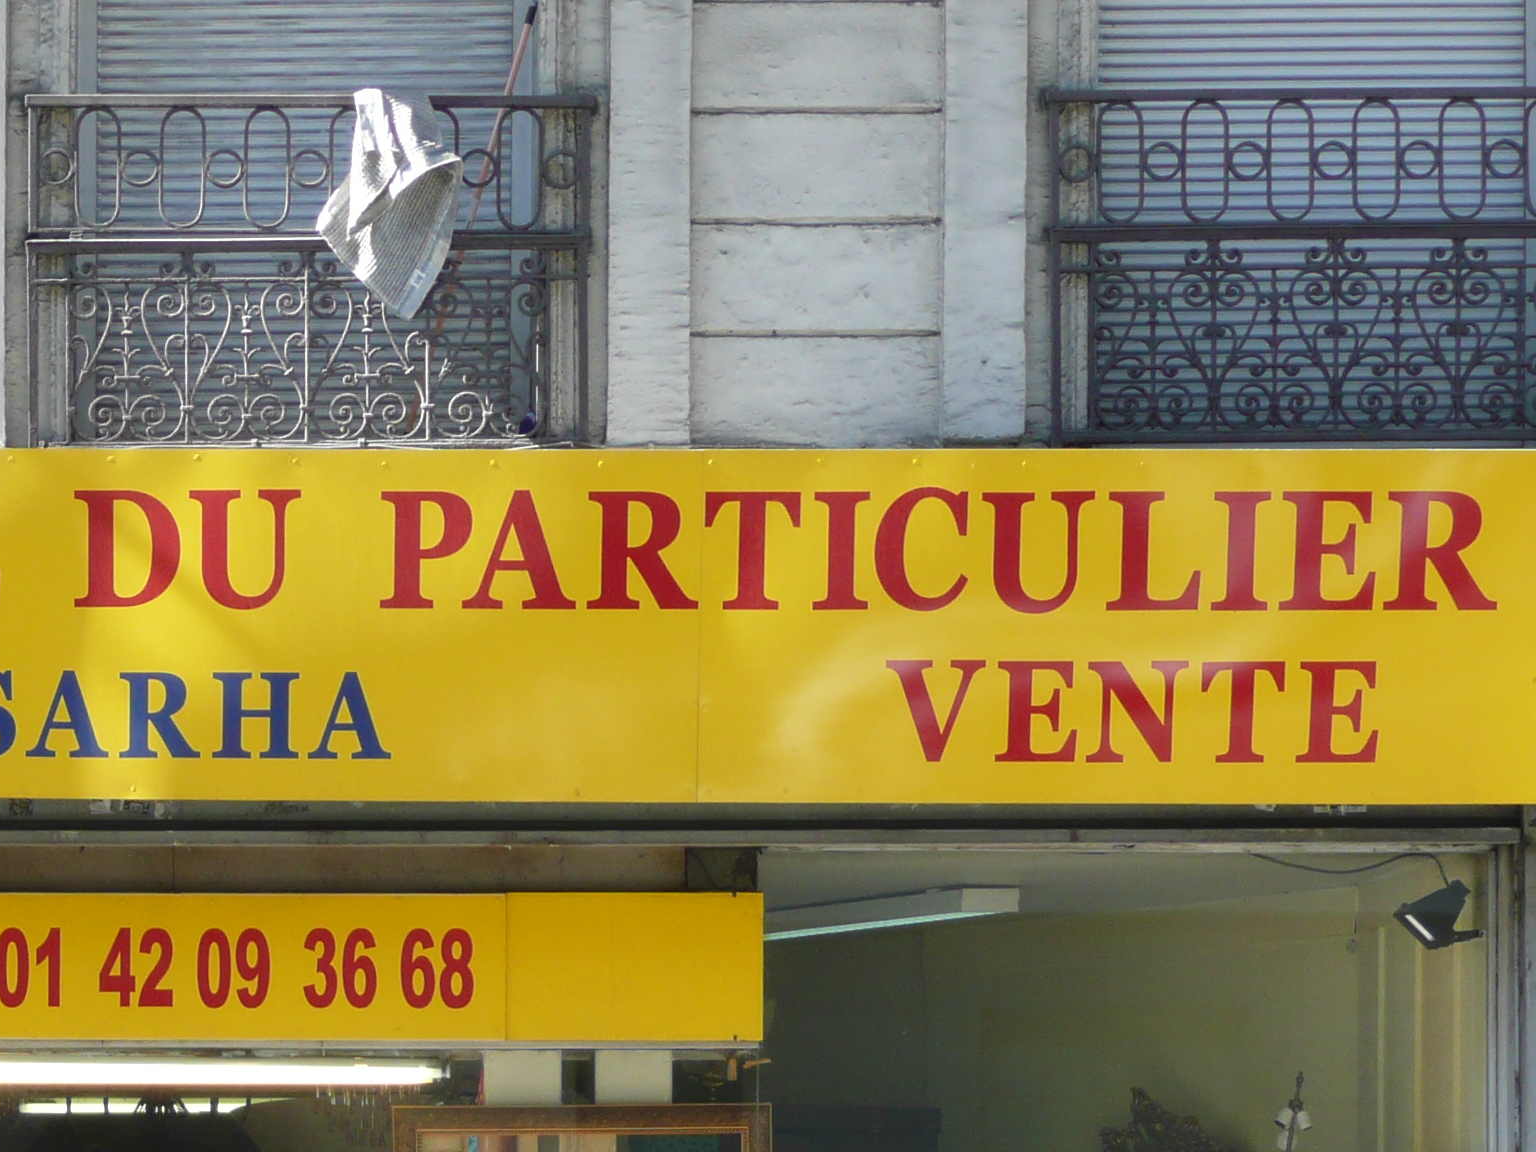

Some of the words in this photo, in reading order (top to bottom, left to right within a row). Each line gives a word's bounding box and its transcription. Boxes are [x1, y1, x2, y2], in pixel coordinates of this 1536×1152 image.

[74, 488, 302, 611] DU
[379, 486, 1498, 615] PARTICULIER
[886, 659, 1379, 764] VENTE
[99, 927, 175, 1008] 42
[197, 927, 271, 1009] 09
[303, 926, 378, 1009] 36
[400, 927, 475, 1010] 68
